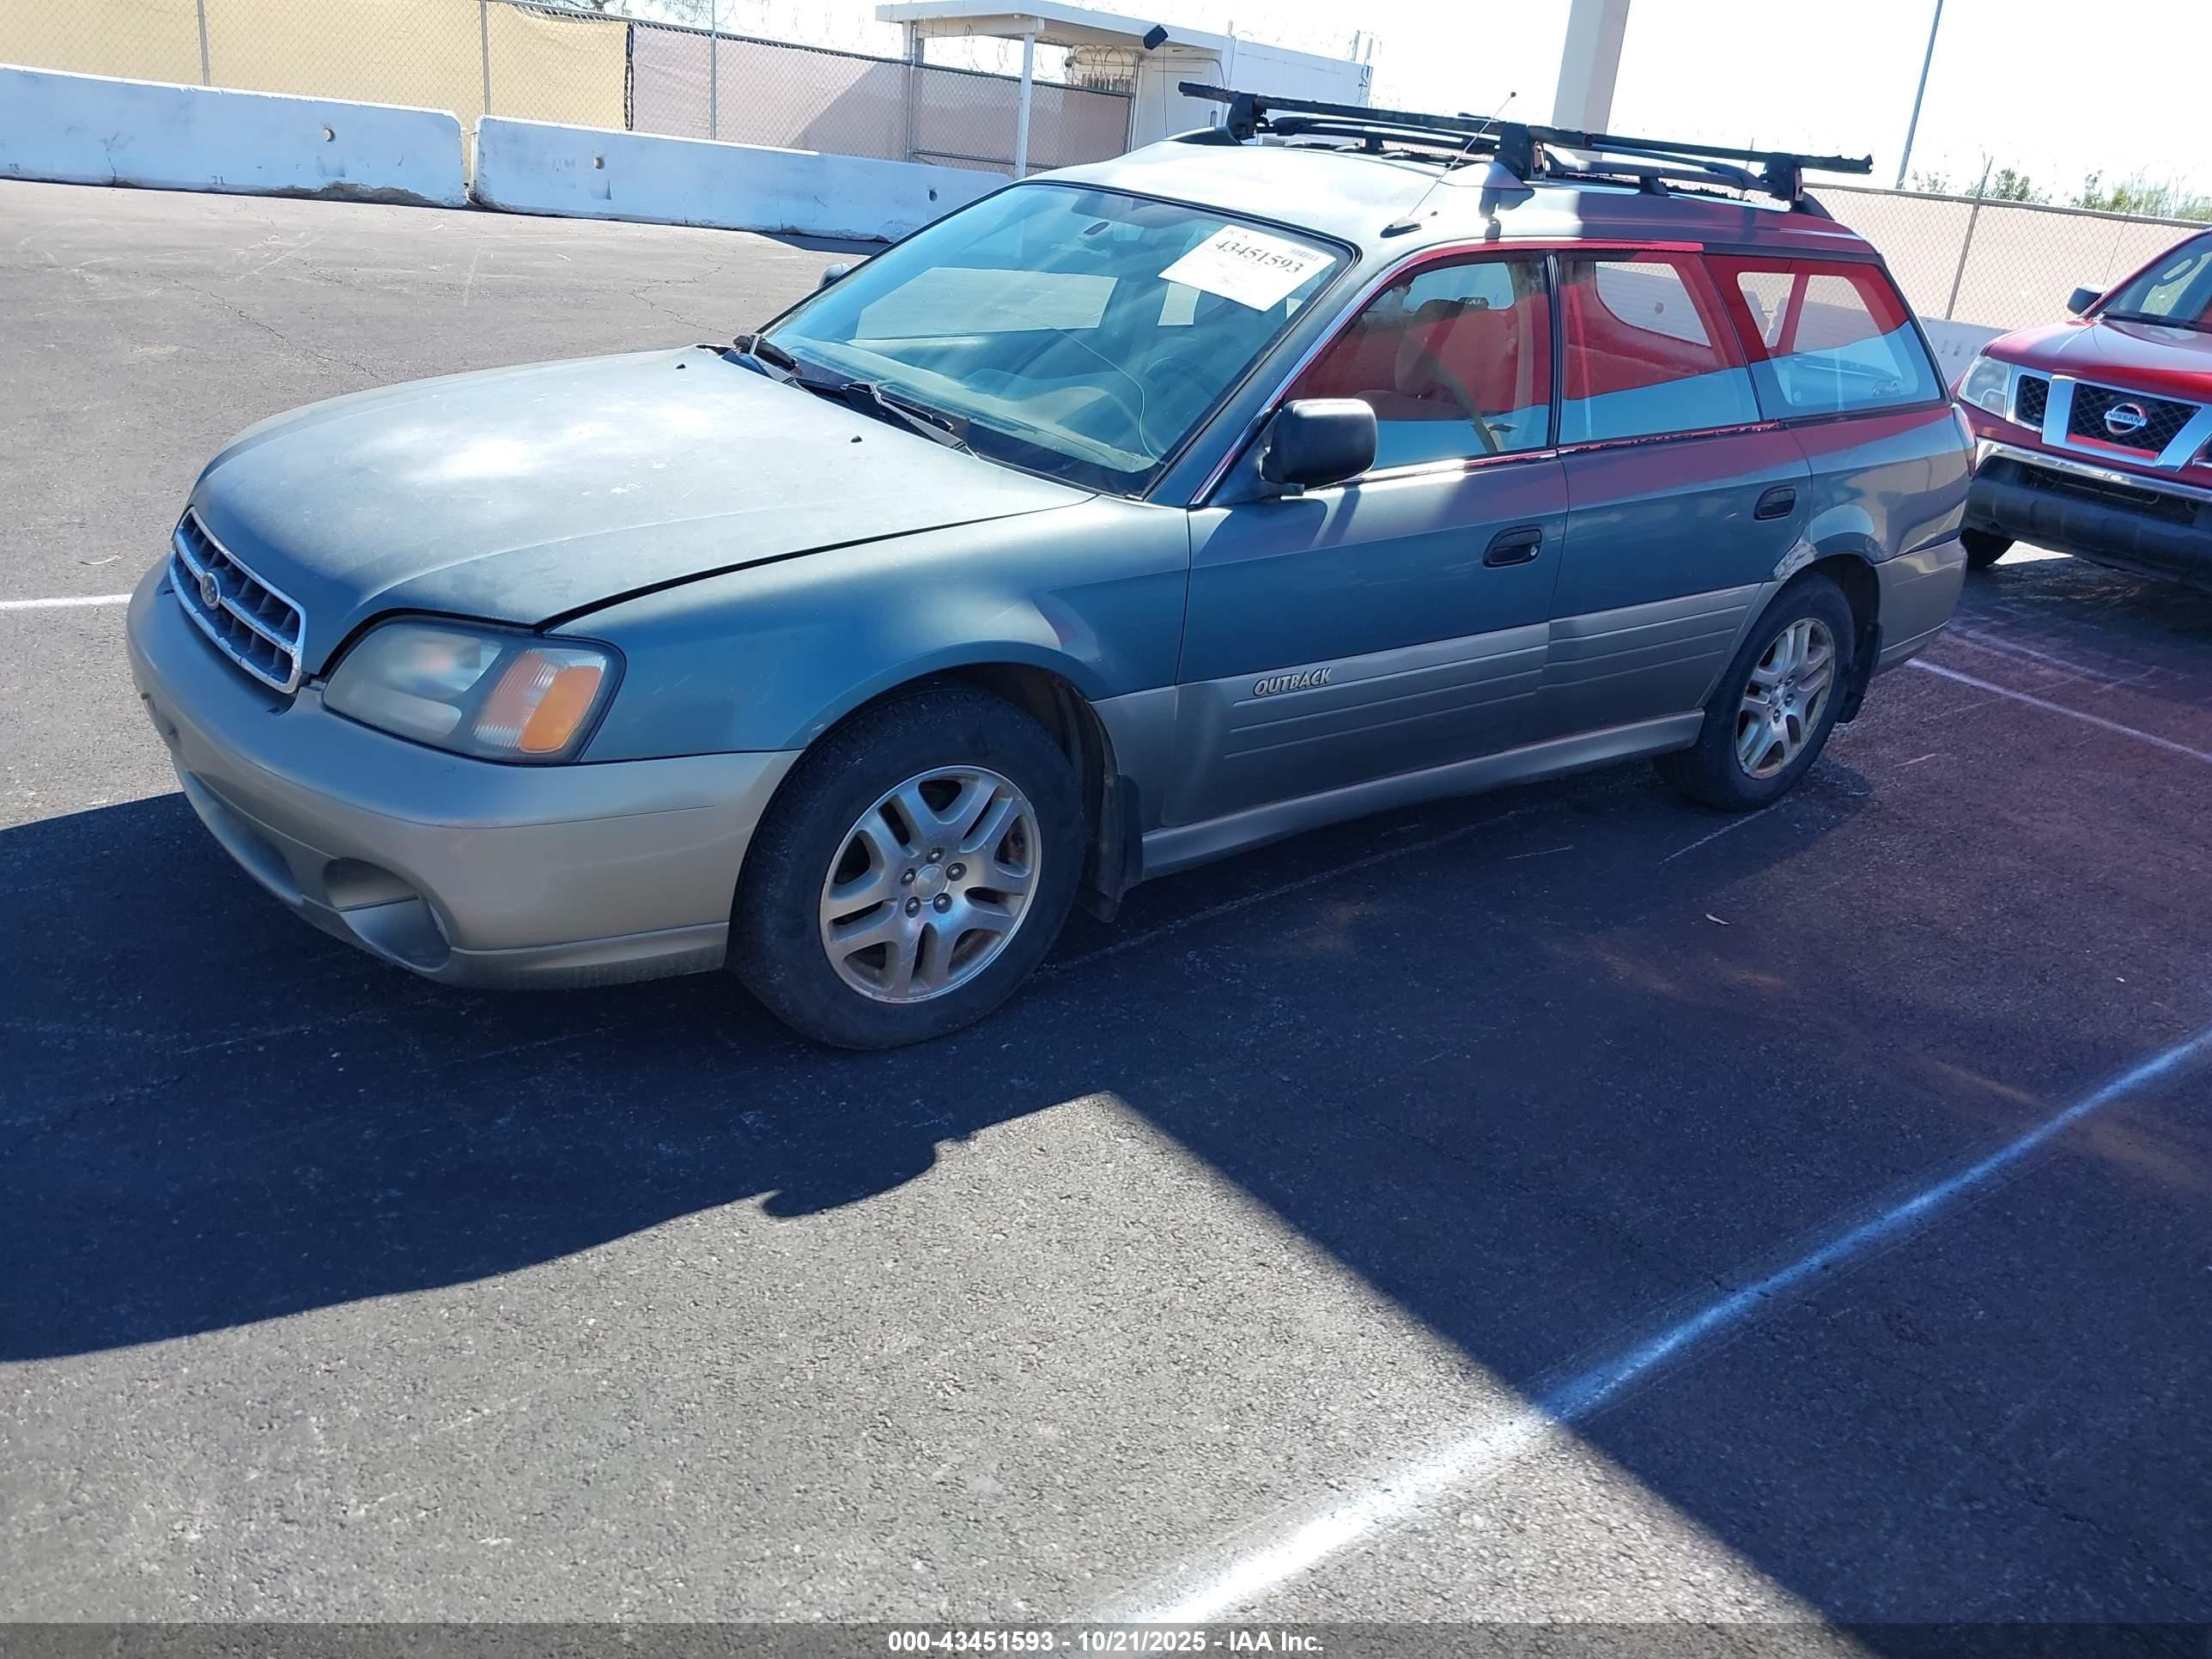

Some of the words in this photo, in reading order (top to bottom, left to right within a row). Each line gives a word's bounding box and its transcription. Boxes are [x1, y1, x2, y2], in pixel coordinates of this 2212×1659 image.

[1215, 240, 1304, 274] 43451593
[2107, 412, 2142, 424] NISSAN
[1254, 667, 1333, 696] OUTBACK
